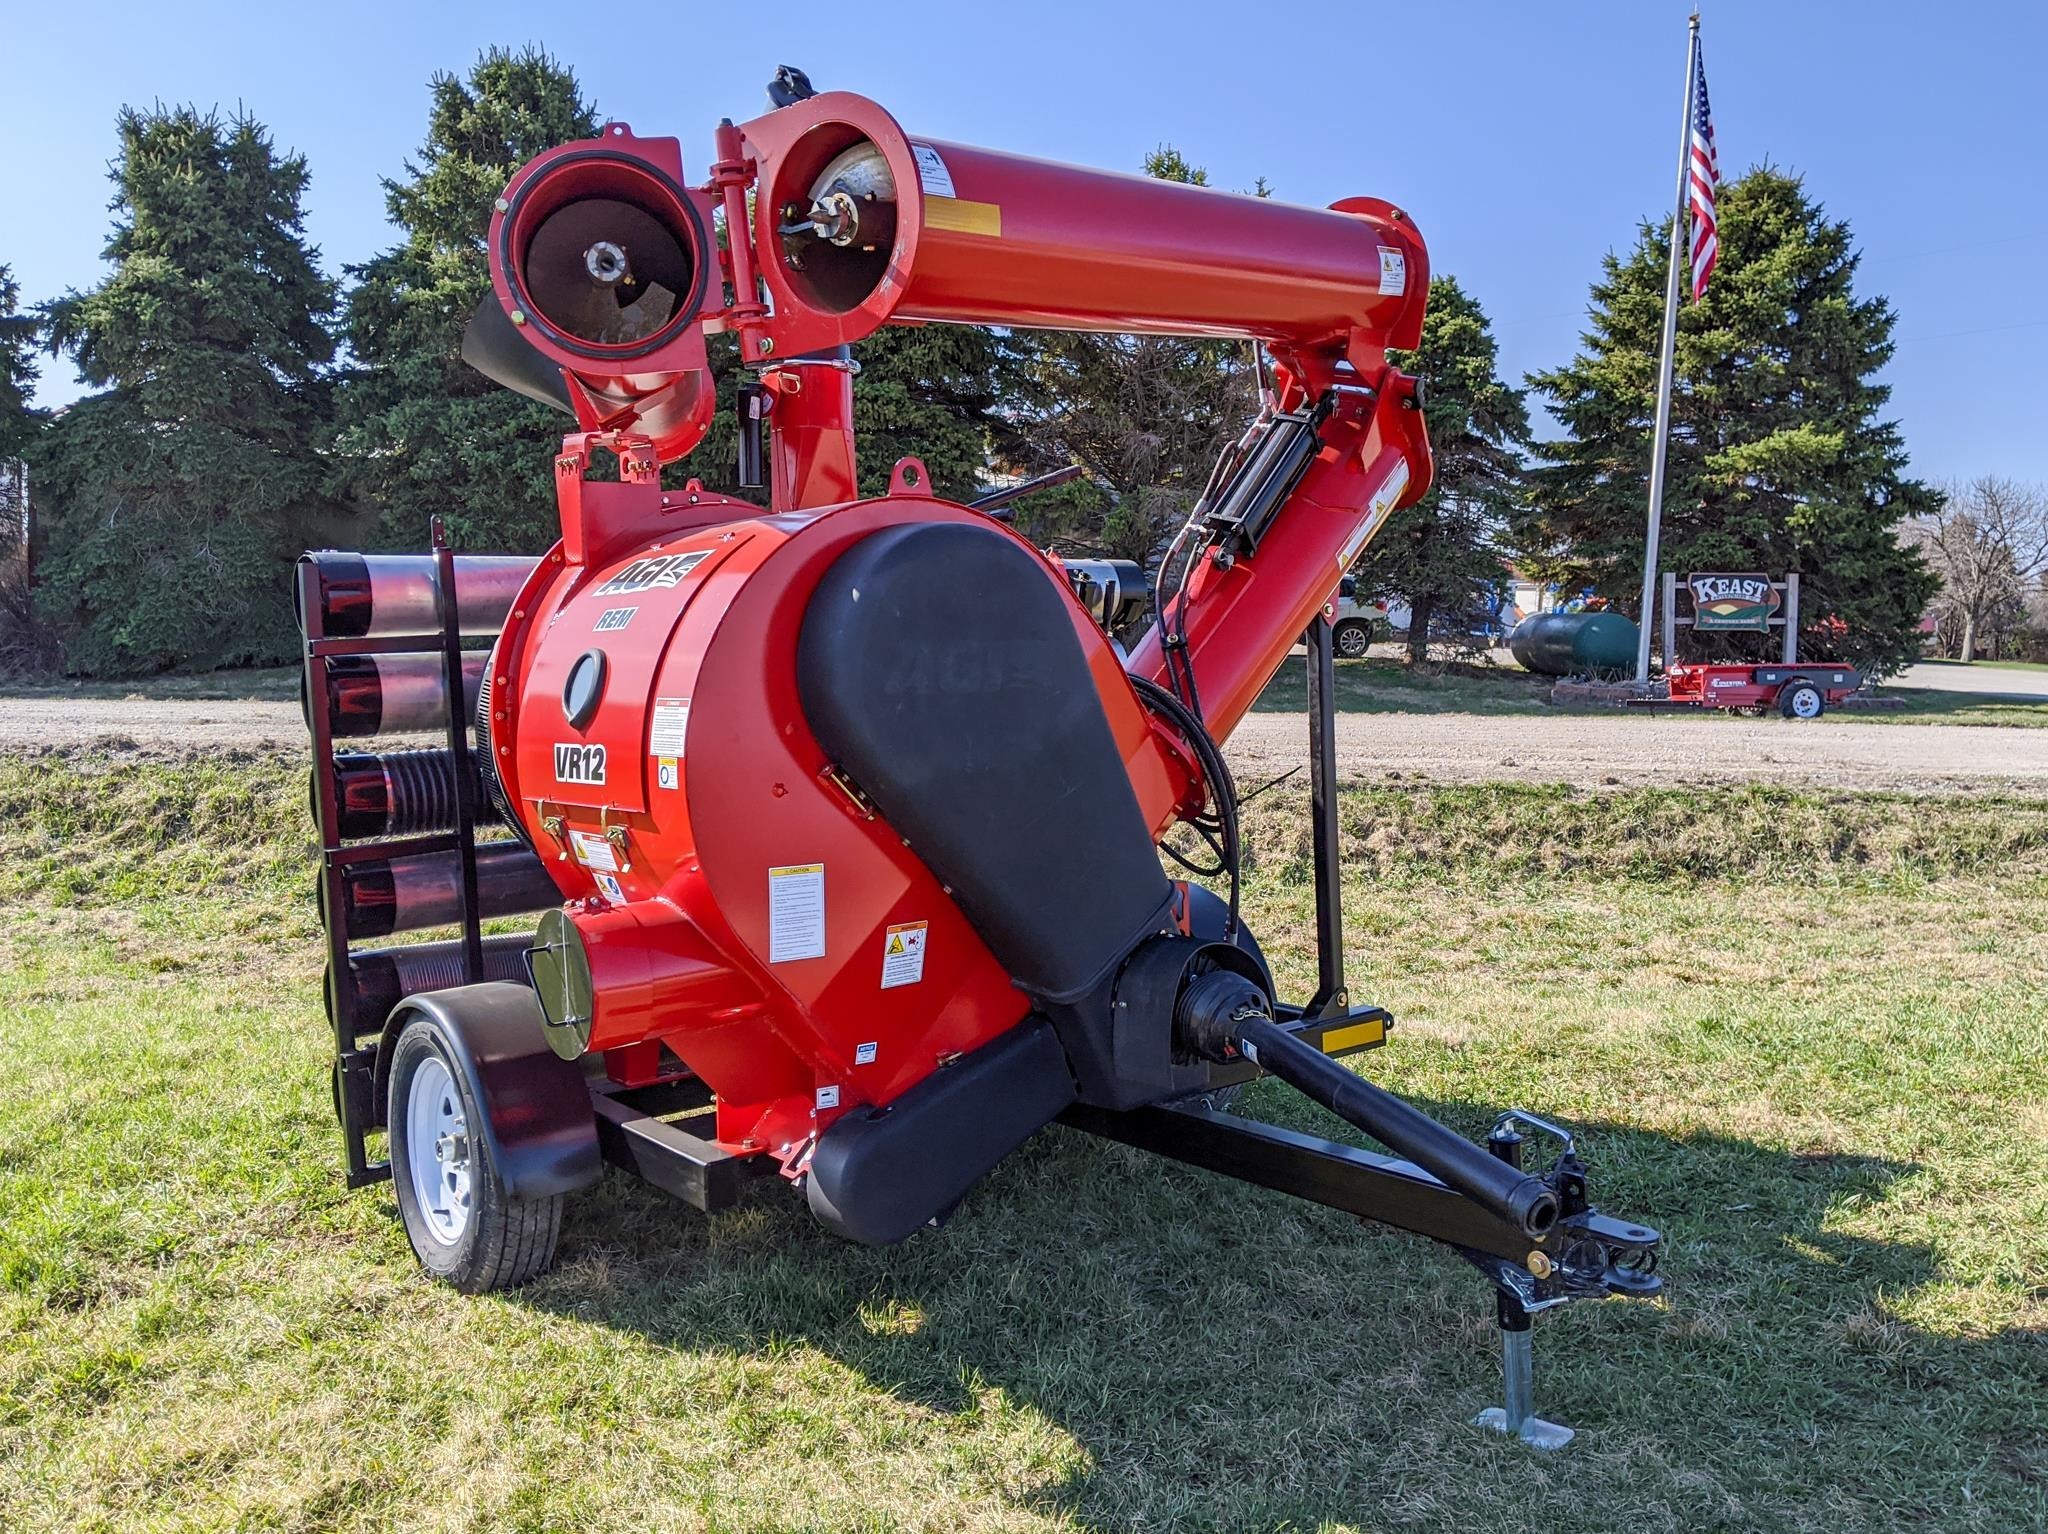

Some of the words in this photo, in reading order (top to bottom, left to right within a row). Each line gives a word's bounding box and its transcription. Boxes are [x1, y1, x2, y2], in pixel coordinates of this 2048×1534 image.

[597, 554, 683, 593] AGI
[1693, 577, 1768, 603] KEAST
[595, 608, 636, 629] REM
[556, 746, 605, 782] VR12
